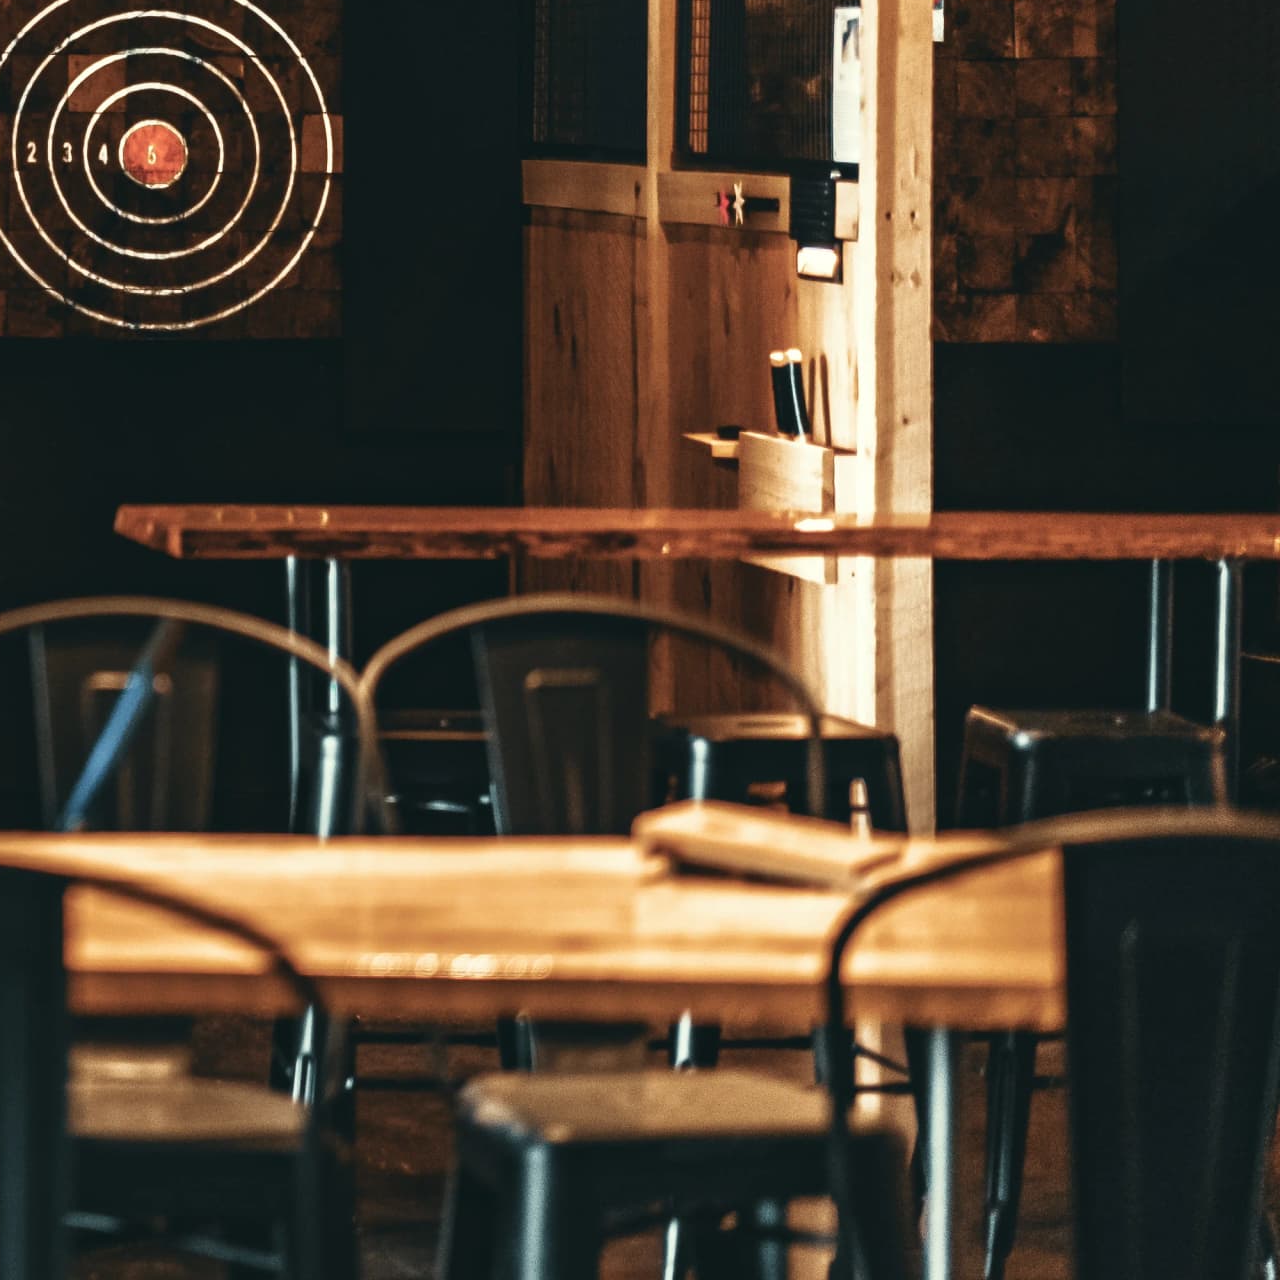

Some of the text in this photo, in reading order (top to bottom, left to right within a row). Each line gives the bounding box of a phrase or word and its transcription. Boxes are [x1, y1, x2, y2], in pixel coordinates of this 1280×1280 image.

[27, 141, 37, 163] 2
[63, 142, 73, 163] 3
[98, 143, 108, 165] 4
